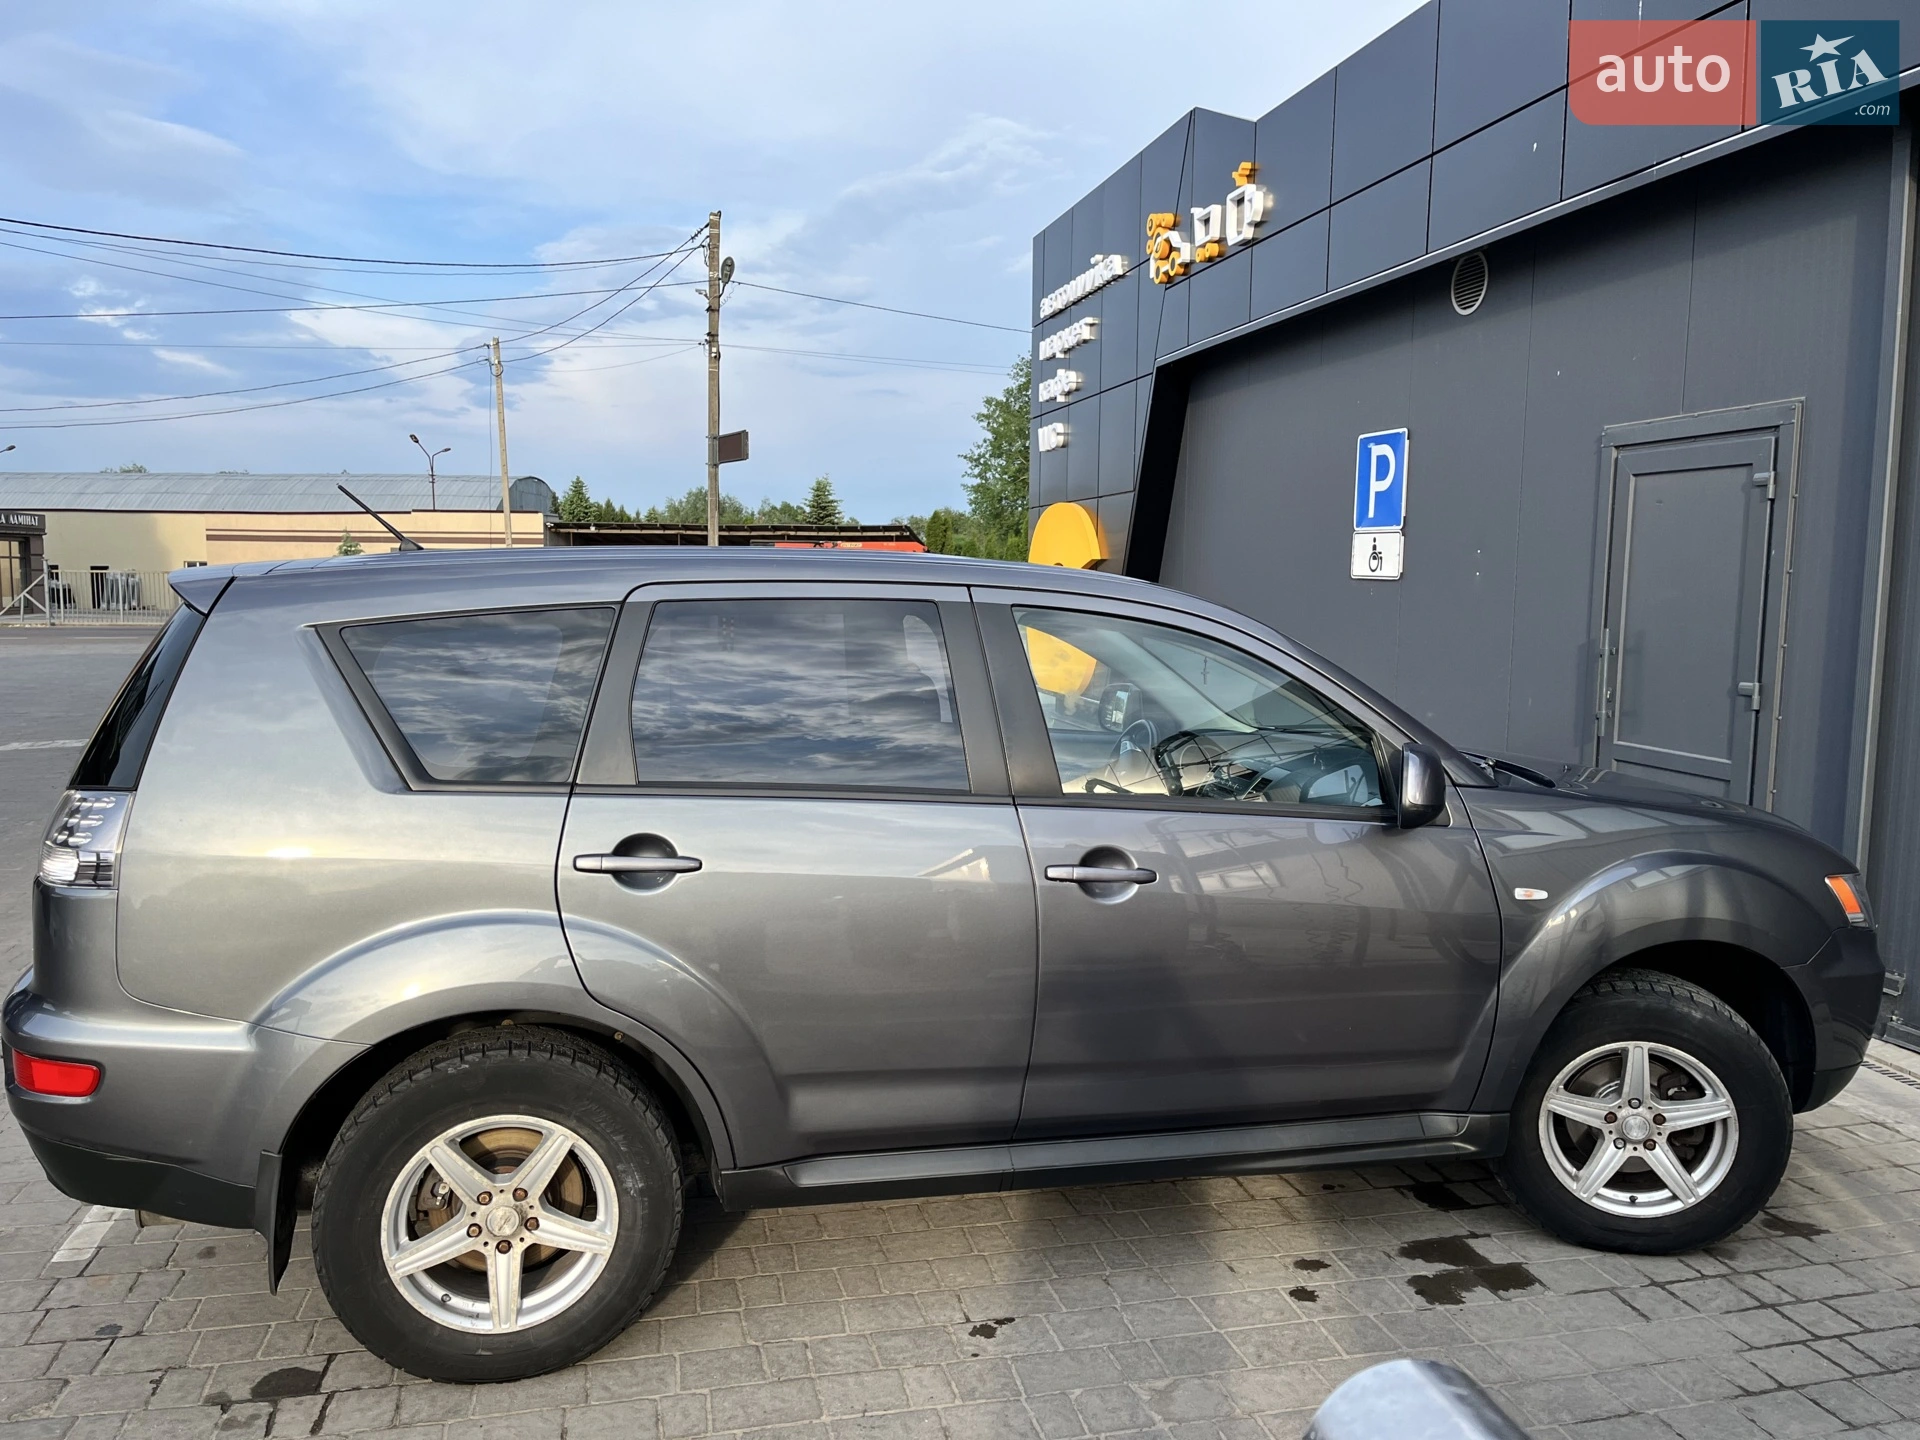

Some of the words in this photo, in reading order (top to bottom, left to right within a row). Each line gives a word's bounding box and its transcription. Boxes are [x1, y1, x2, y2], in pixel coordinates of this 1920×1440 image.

[1038, 316, 1096, 361] маркет
[1038, 368, 1078, 403] кафе
[1367, 443, 1396, 519] P
